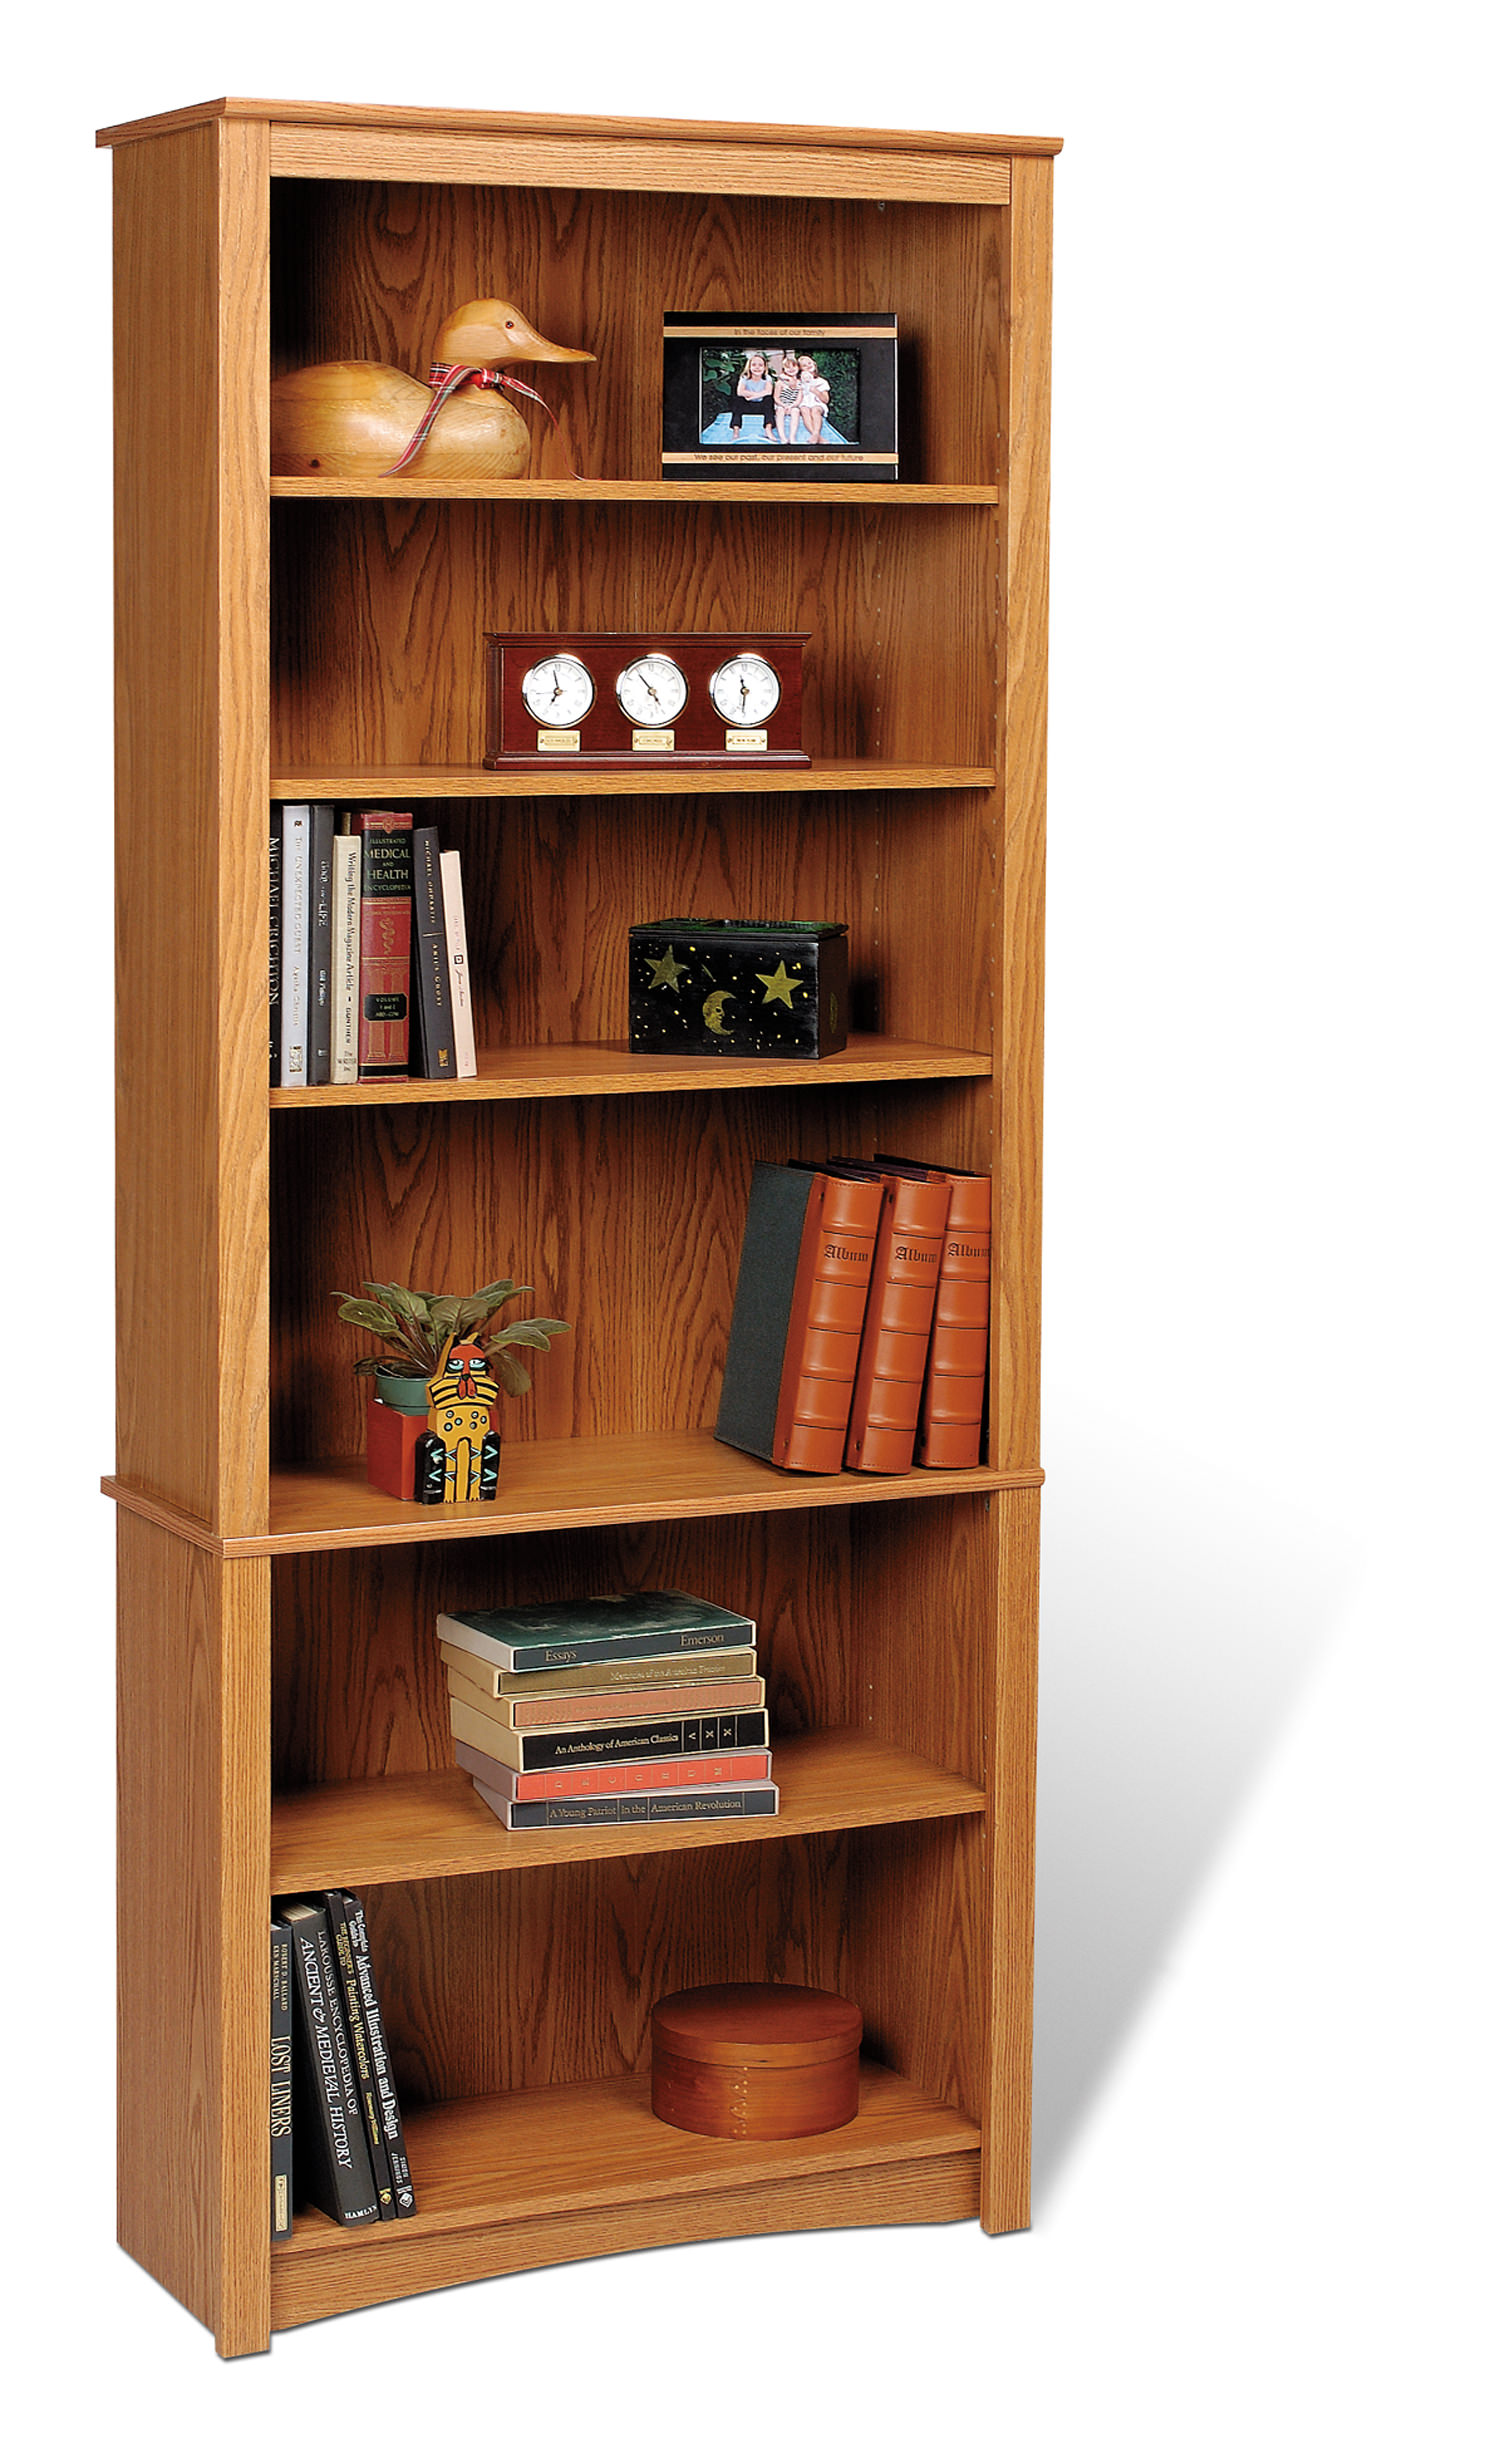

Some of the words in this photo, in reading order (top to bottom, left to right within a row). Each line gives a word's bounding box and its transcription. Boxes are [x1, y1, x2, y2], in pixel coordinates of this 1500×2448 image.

[345, 851, 357, 882] Writing
[363, 848, 411, 859] MEDICAL
[367, 869, 409, 879] HEALTH
[346, 896, 356, 926] Modern
[344, 927, 356, 964] Magazine
[345, 963, 355, 991] Article
[824, 1244, 869, 1262] Album
[895, 1246, 938, 1263] Album
[680, 1634, 725, 1647] Emerson
[545, 1650, 577, 1663] Essays
[555, 1745, 567, 1755] An
[567, 1740, 605, 1753] Anthology
[605, 1739, 616, 1749] of
[615, 1737, 650, 1748] American
[650, 1734, 679, 1744] Classics
[550, 1809, 558, 1818] A
[558, 1808, 586, 1819] Young
[631, 1804, 646, 1814] the
[651, 1802, 693, 1813] American
[694, 1800, 742, 1811] Revolution
[300, 1936, 324, 2006] ANCIENT
[355, 1955, 378, 2008] Advanced
[312, 2007, 326, 2023] &
[346, 1978, 360, 2022] Painting
[317, 1931, 337, 1996] LAROUSSE
[329, 1998, 354, 2097] ENCYCLOPEDIA
[347, 2098, 358, 2115] OF
[271, 2035, 291, 2073] LOST
[352, 2022, 370, 2080] Watercolors
[366, 2008, 387, 2075] Illustration
[314, 2025, 341, 2103] MEDIEVAL
[378, 2077, 394, 2099] and
[271, 2080, 291, 2136] LINERS
[382, 2098, 399, 2140] Design
[329, 2106, 353, 2169] HISTORY
[344, 2204, 377, 2219] HAMLYN
